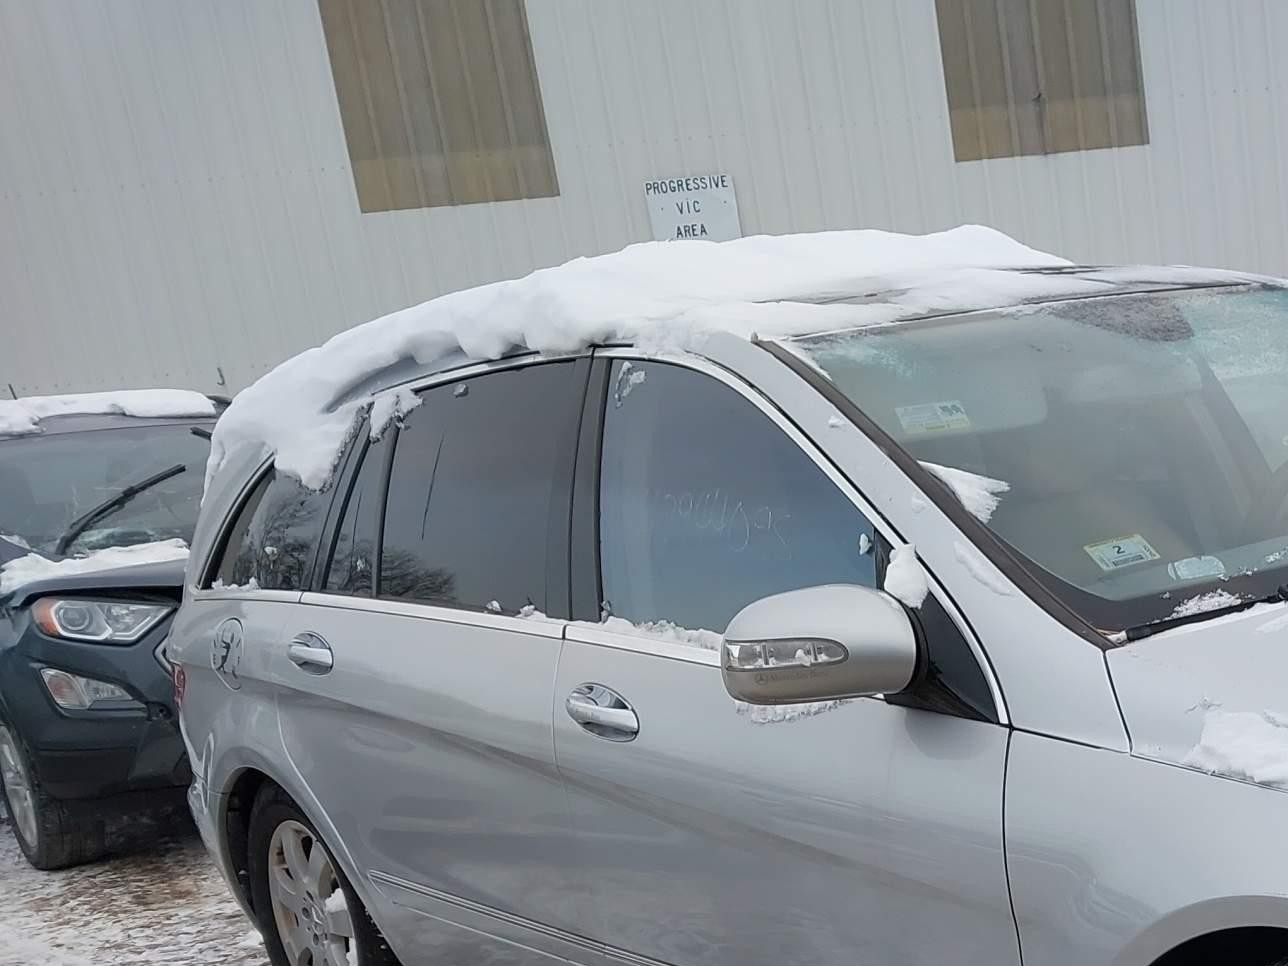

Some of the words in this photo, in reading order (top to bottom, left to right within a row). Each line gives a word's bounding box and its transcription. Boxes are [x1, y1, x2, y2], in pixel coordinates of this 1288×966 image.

[645, 175, 728, 195] PROGRESSIVE
[676, 200, 701, 215] VIC
[676, 223, 708, 239] AREA
[1112, 545, 1126, 555] 2
